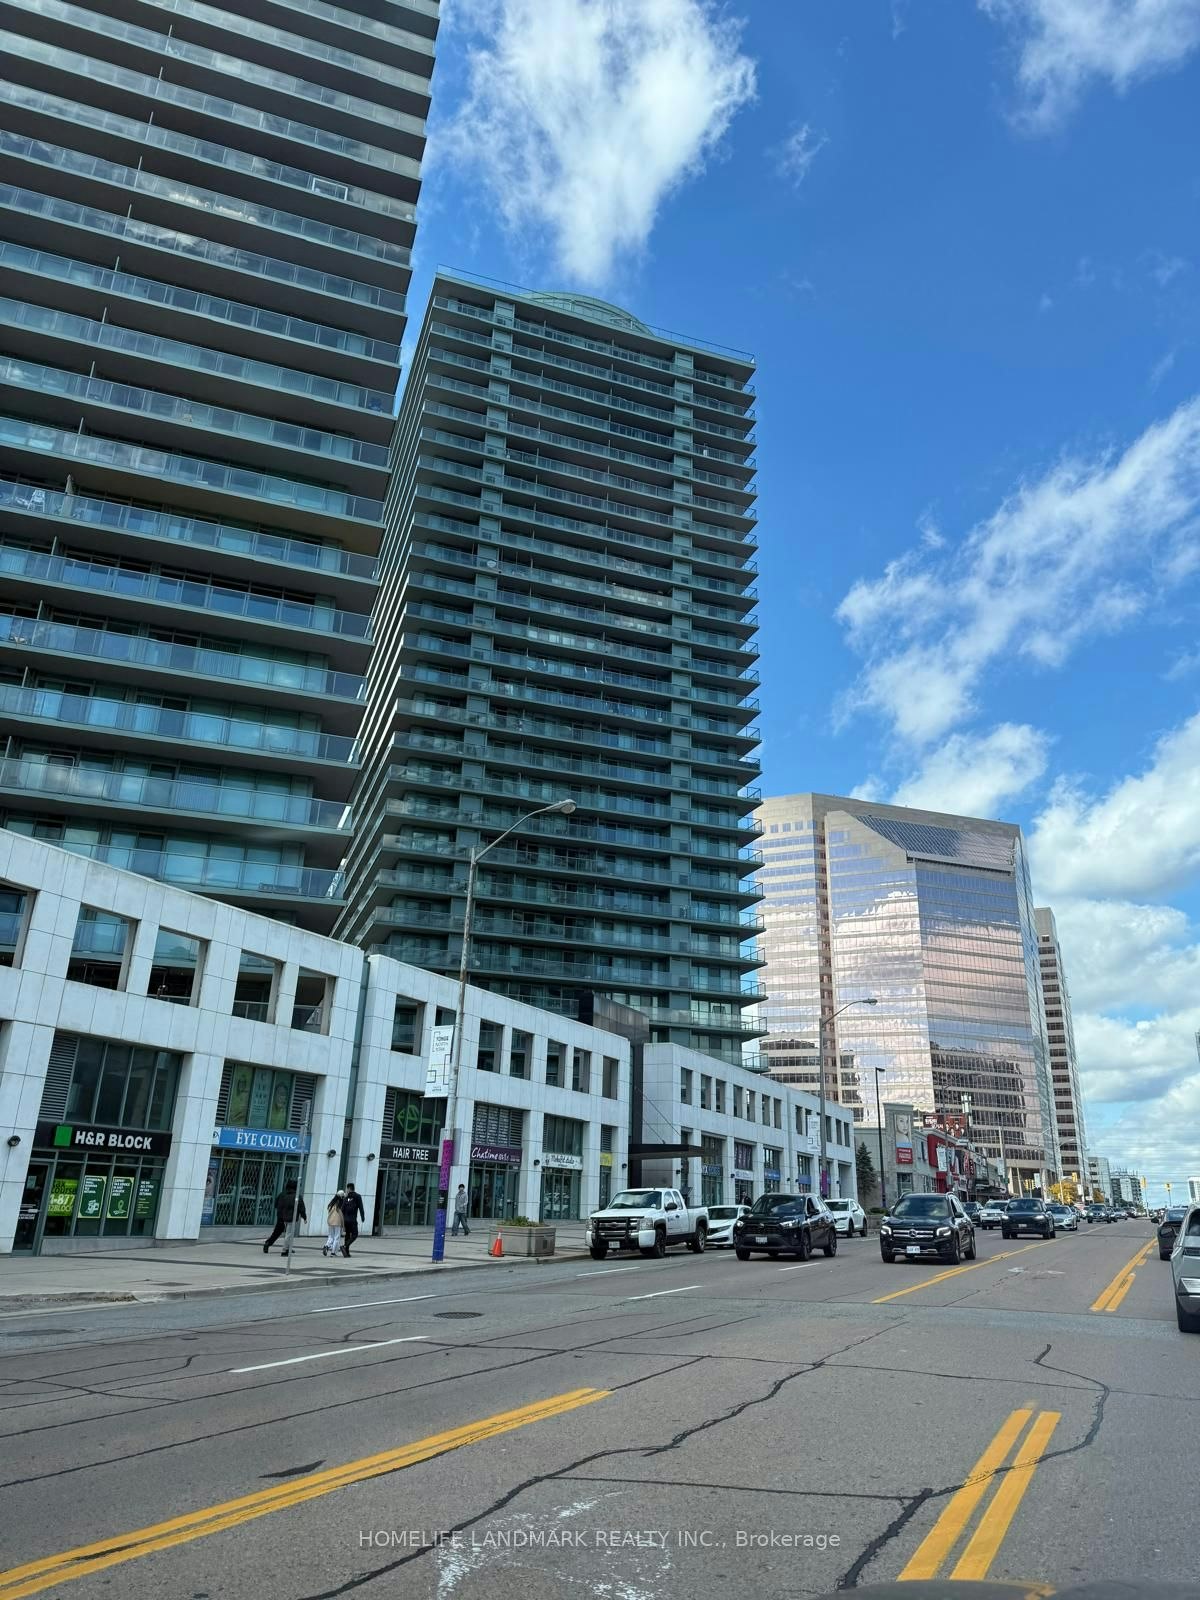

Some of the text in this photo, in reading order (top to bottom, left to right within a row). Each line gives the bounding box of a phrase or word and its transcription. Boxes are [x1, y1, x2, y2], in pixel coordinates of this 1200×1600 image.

[75, 1130, 153, 1150] H&R BLOCK
[236, 1131, 298, 1150] EYE CLINIC
[393, 1146, 430, 1161] HAIR TREE
[471, 1146, 498, 1160] Chatime
